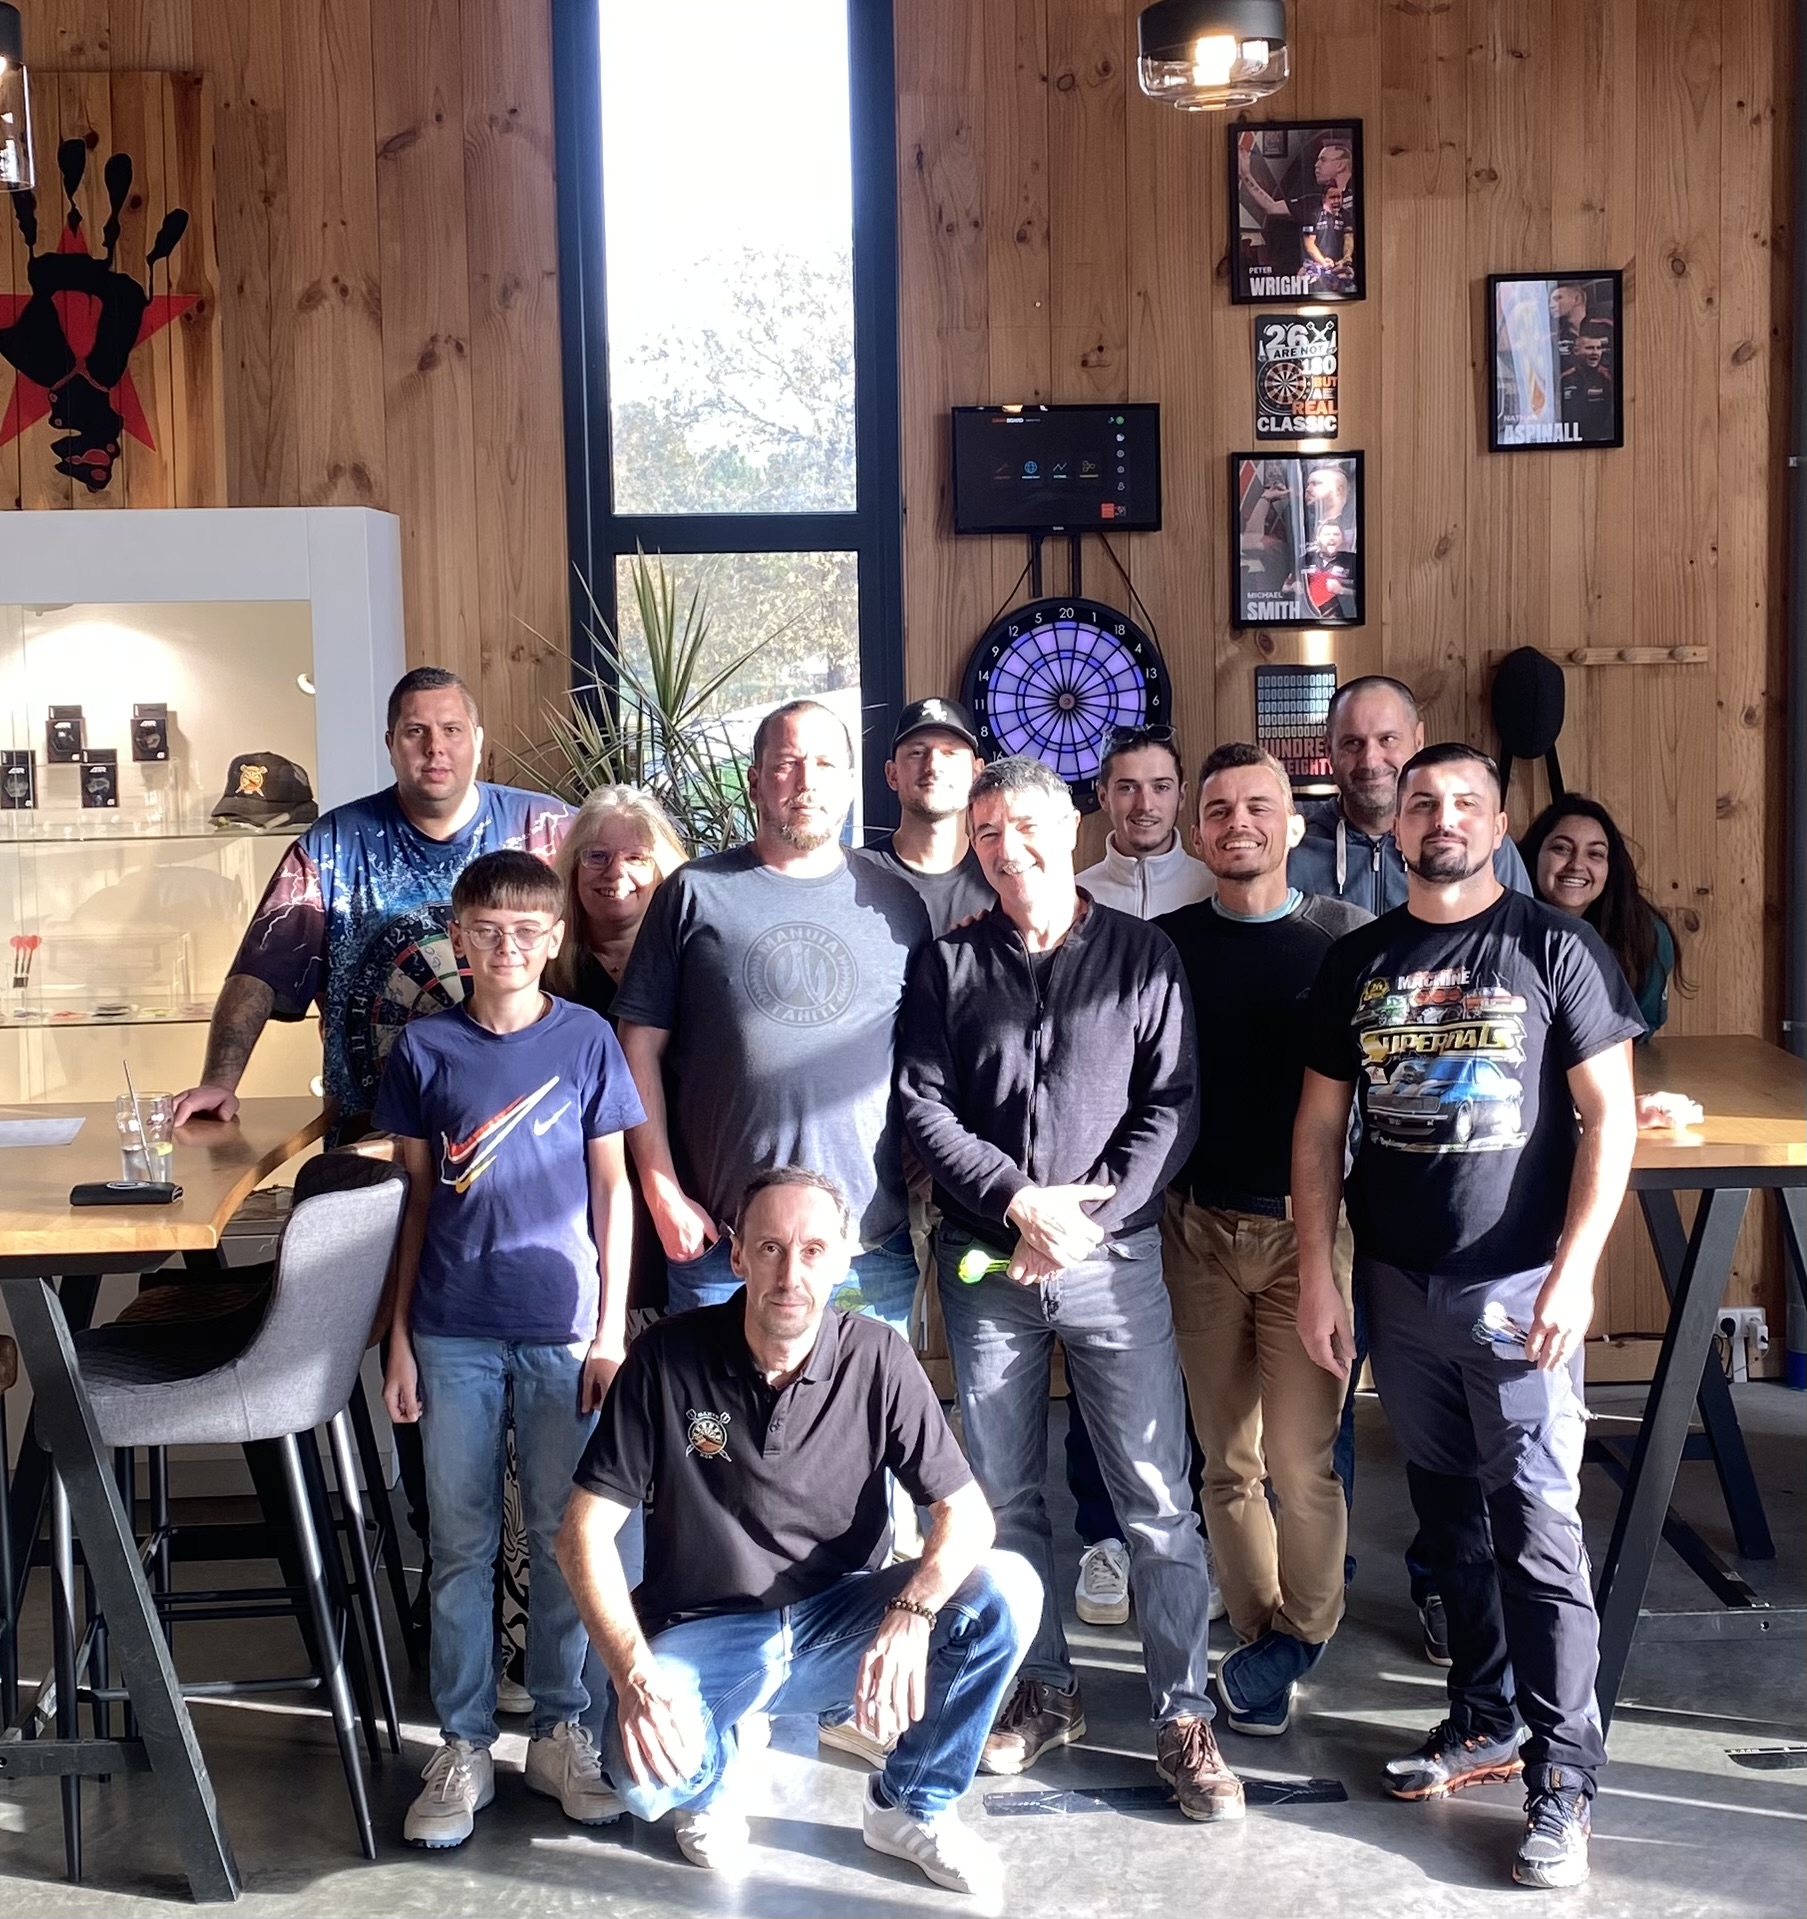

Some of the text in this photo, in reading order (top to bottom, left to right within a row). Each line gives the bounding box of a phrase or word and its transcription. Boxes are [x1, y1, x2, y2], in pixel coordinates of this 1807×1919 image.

[1249, 266, 1272, 274] PETER
[1250, 275, 1310, 296] WRIGHT
[1265, 324, 1309, 348] 26
[1273, 344, 1324, 360] ARE NOT
[1301, 355, 1337, 375] 180
[1312, 376, 1338, 387] BUT
[1291, 400, 1338, 415] REAL
[1257, 415, 1337, 432] CLASSIC
[1503, 422, 1582, 443] ASPINALL
[1247, 591, 1283, 599] MICHAEL
[1059, 607, 1075, 619] 20
[1247, 601, 1300, 620] SMITH
[1035, 613, 1043, 623] 5
[1091, 612, 1097, 622] 1
[1009, 625, 1019, 637] 12
[1115, 624, 1126, 636] 18
[992, 645, 999, 657] 9
[1134, 643, 1142, 653] 4
[978, 670, 989, 682] 14
[1145, 667, 1157, 679] 13
[974, 699, 985, 710] 11
[1152, 694, 1160, 706] 6
[980, 725, 988, 737] 8
[1260, 738, 1329, 758] HUNDRE
[1397, 966, 1471, 990] MACHINE
[772, 1002, 838, 1021] TAHITI
